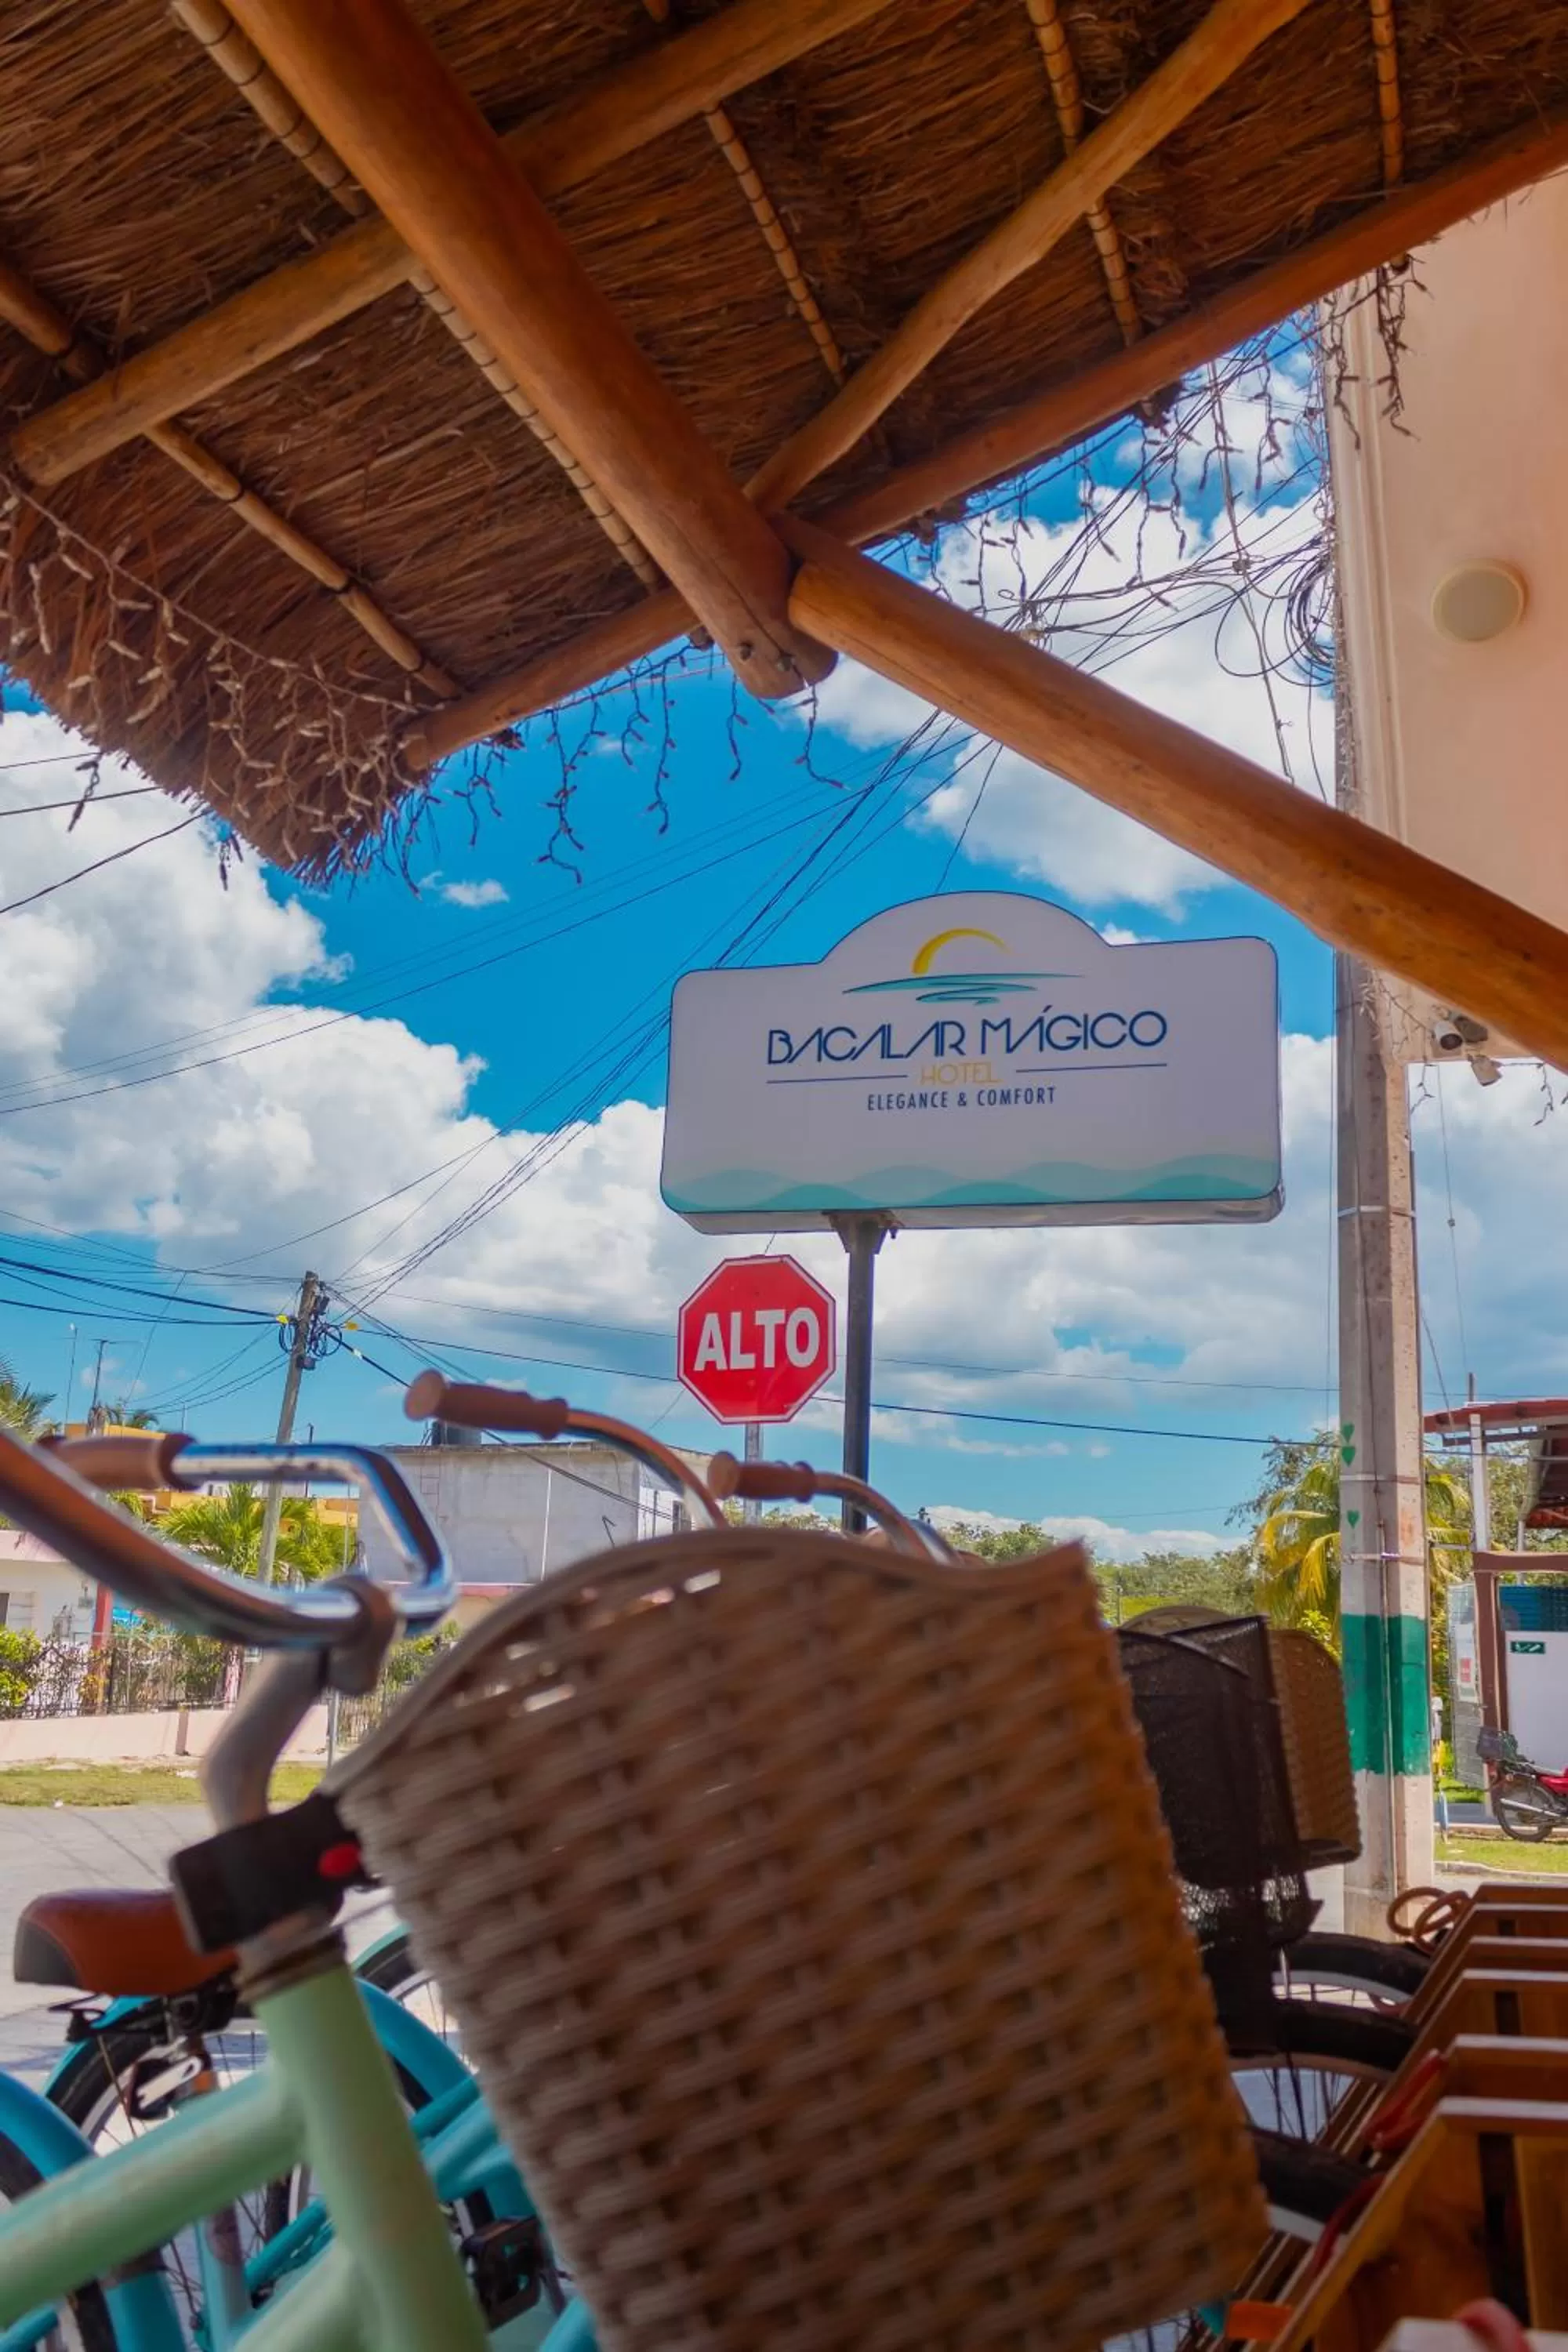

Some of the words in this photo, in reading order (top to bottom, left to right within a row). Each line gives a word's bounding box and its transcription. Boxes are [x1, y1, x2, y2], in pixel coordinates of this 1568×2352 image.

[768, 1020, 966, 1065] BACALAR
[981, 1004, 1167, 1054] MÁGICO
[920, 1062, 1003, 1086] HOTEL
[867, 1091, 949, 1111] ELEGANCE
[956, 1091, 967, 1108] &
[977, 1087, 1057, 1107] COMFORT
[693, 1307, 820, 1372] ALTO
